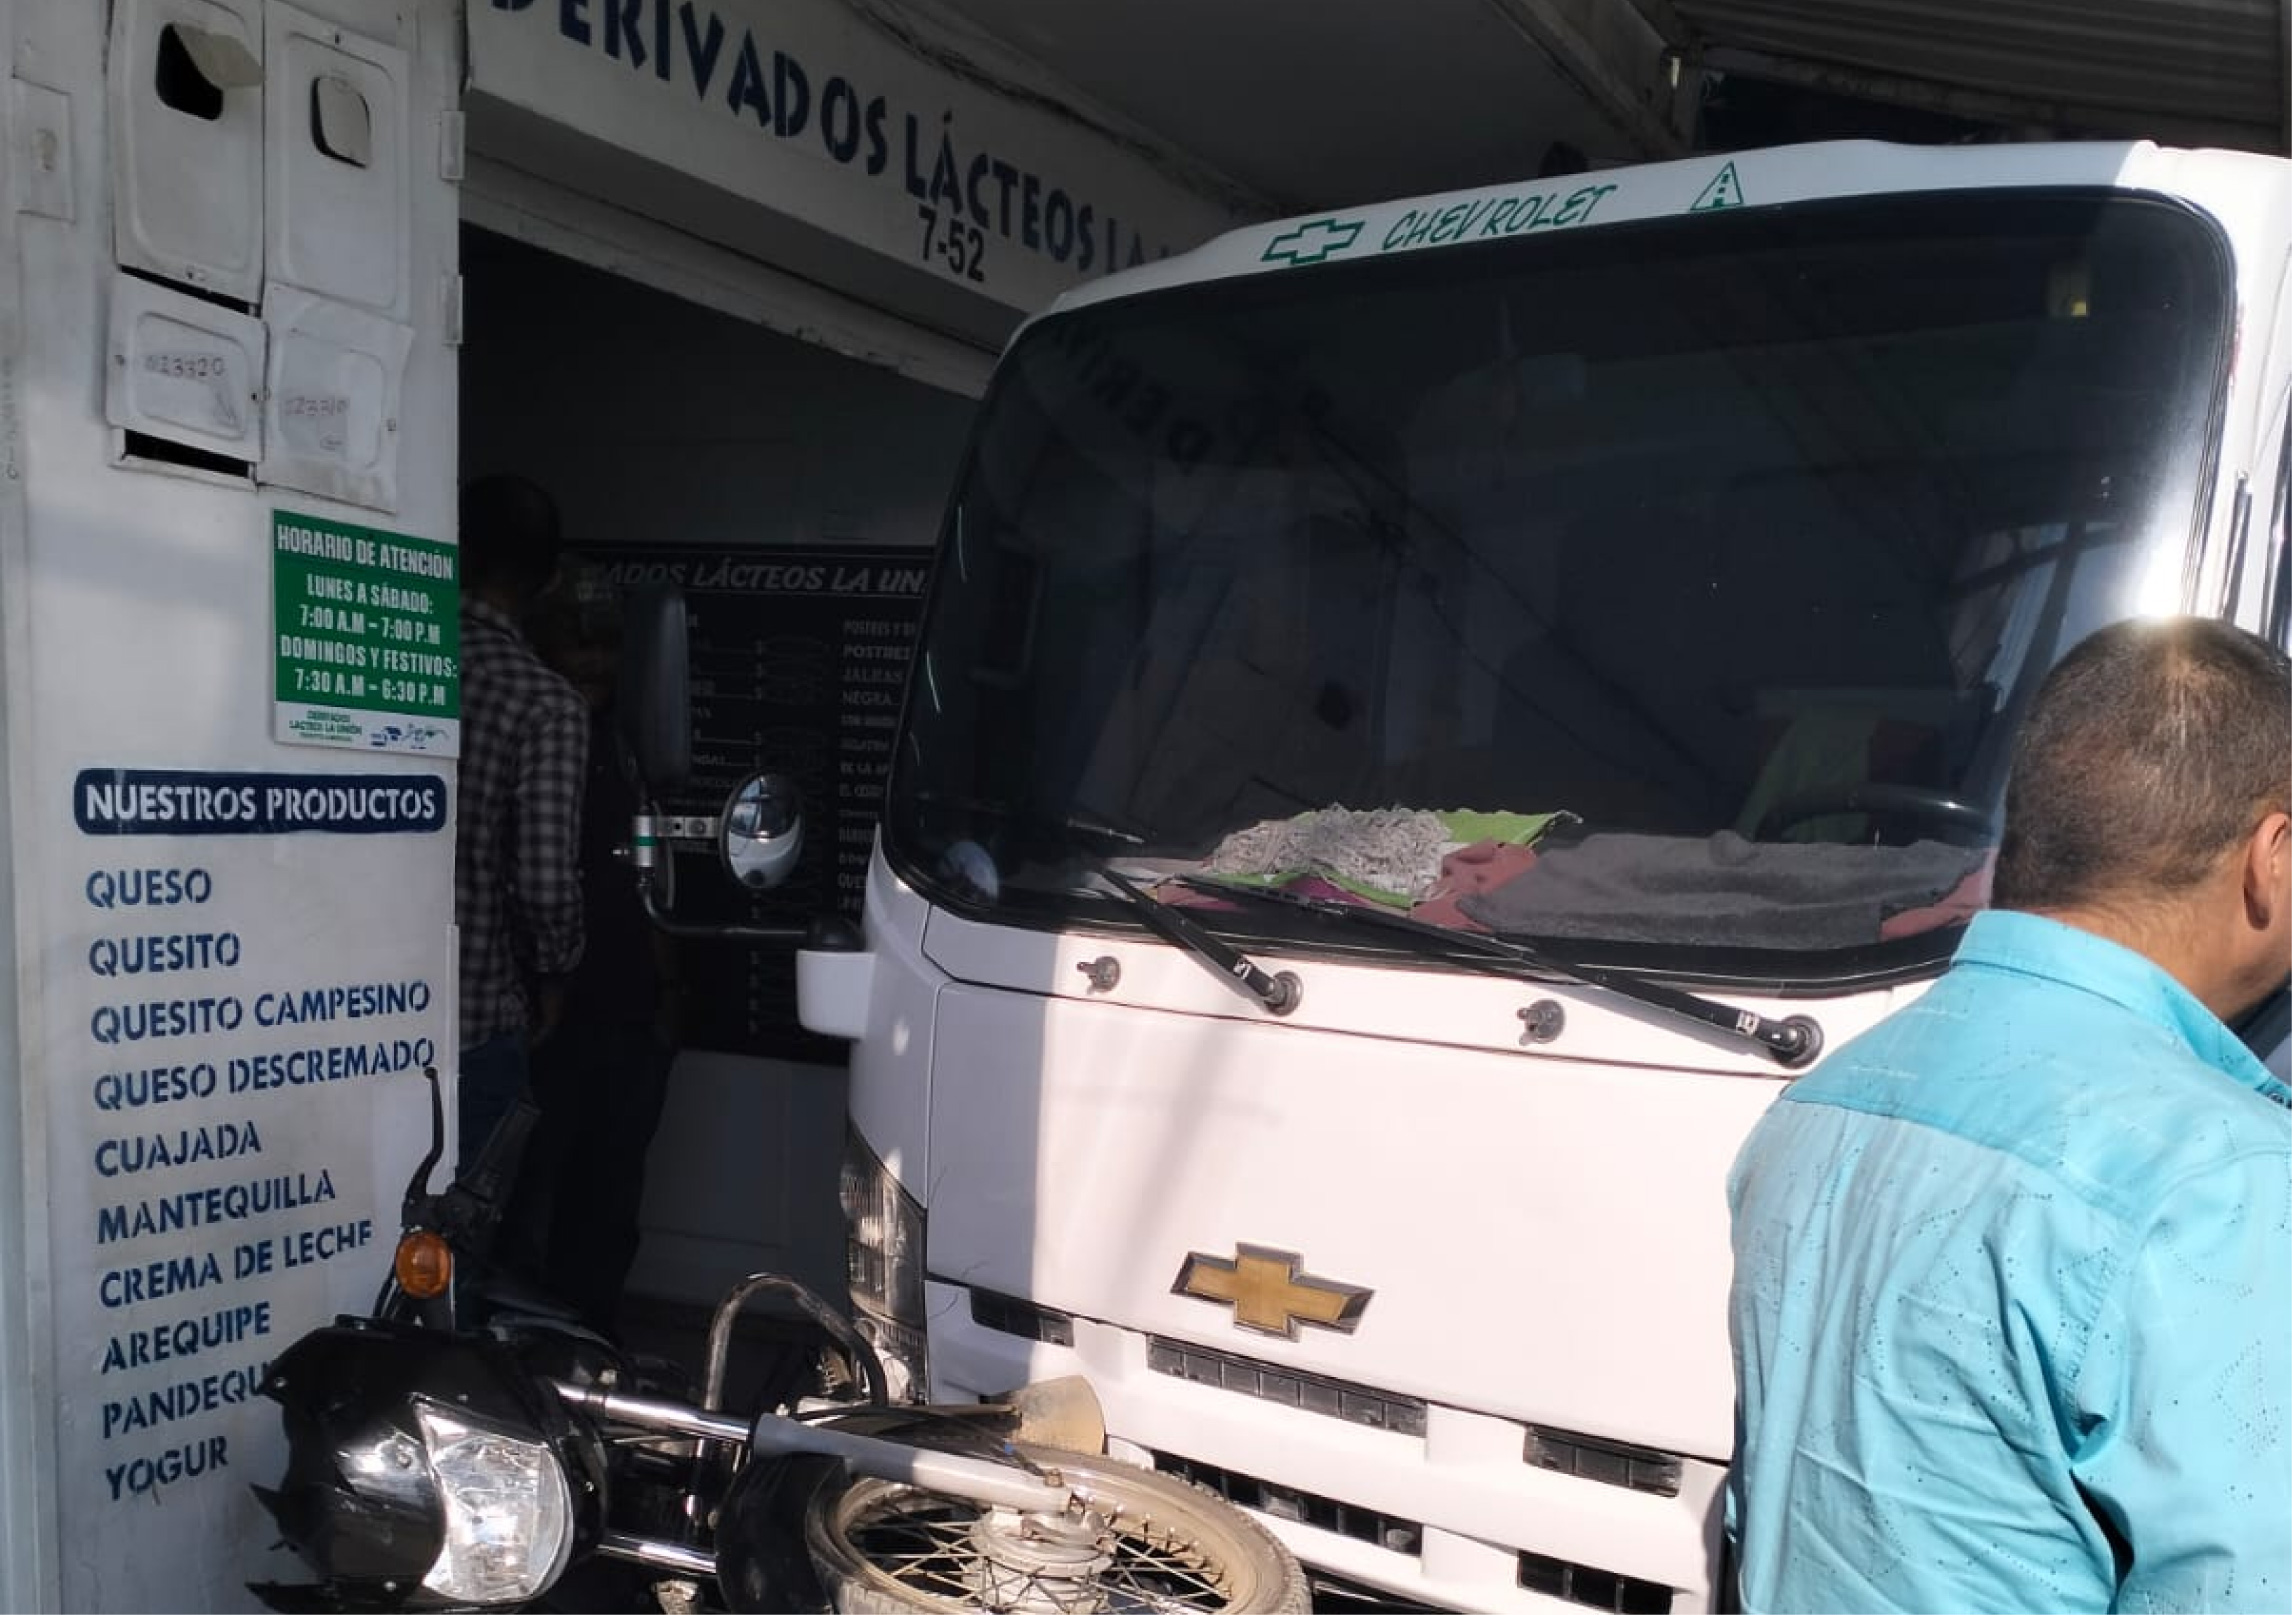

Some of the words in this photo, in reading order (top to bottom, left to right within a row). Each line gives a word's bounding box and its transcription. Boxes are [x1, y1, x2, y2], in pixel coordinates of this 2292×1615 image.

[490, 0, 887, 176] ERIVADOS
[905, 111, 1094, 273] LÁCTEOS
[918, 206, 986, 282] 7-52
[1382, 184, 1617, 250] CHEVROLET
[277, 523, 352, 564] HORARIO
[356, 540, 376, 567] DE
[380, 543, 454, 580] ATENCIÓN
[692, 556, 825, 589] LÁCTEOS
[831, 567, 870, 592] LA
[879, 568, 926, 594] UN
[307, 573, 352, 602] LUNES
[357, 583, 368, 604] A
[371, 581, 434, 615] SÁBADO:
[300, 604, 334, 630] 7:00
[337, 609, 365, 635] A.M
[381, 617, 412, 642] 7:00
[415, 621, 441, 645] P.M
[280, 635, 367, 667] DOMINGOS
[370, 648, 380, 670] Y
[384, 649, 458, 679] FESTIVOS:
[295, 668, 331, 693] 7:30
[335, 674, 365, 697] A.M
[381, 678, 415, 702] 6:30
[419, 683, 446, 706] P.M
[86, 784, 257, 821] NUESTROS
[265, 787, 435, 821] PRODUCTOS
[86, 868, 212, 908] QUESO
[89, 932, 241, 977] QUESITO
[91, 996, 243, 1044] QUESITO
[254, 980, 431, 1027] CAMPESINO
[94, 1063, 216, 1110] QUESO
[229, 1037, 434, 1094] DESCREMADO
[95, 1121, 261, 1178] CUAJADA
[98, 1169, 336, 1244] MANTEQUILLA
[100, 1253, 223, 1308] CREMA
[234, 1240, 273, 1279] DE
[101, 1302, 271, 1374] AREQUIPE
[102, 1361, 269, 1439] PANDEQU
[105, 1436, 228, 1501] YOGUR
